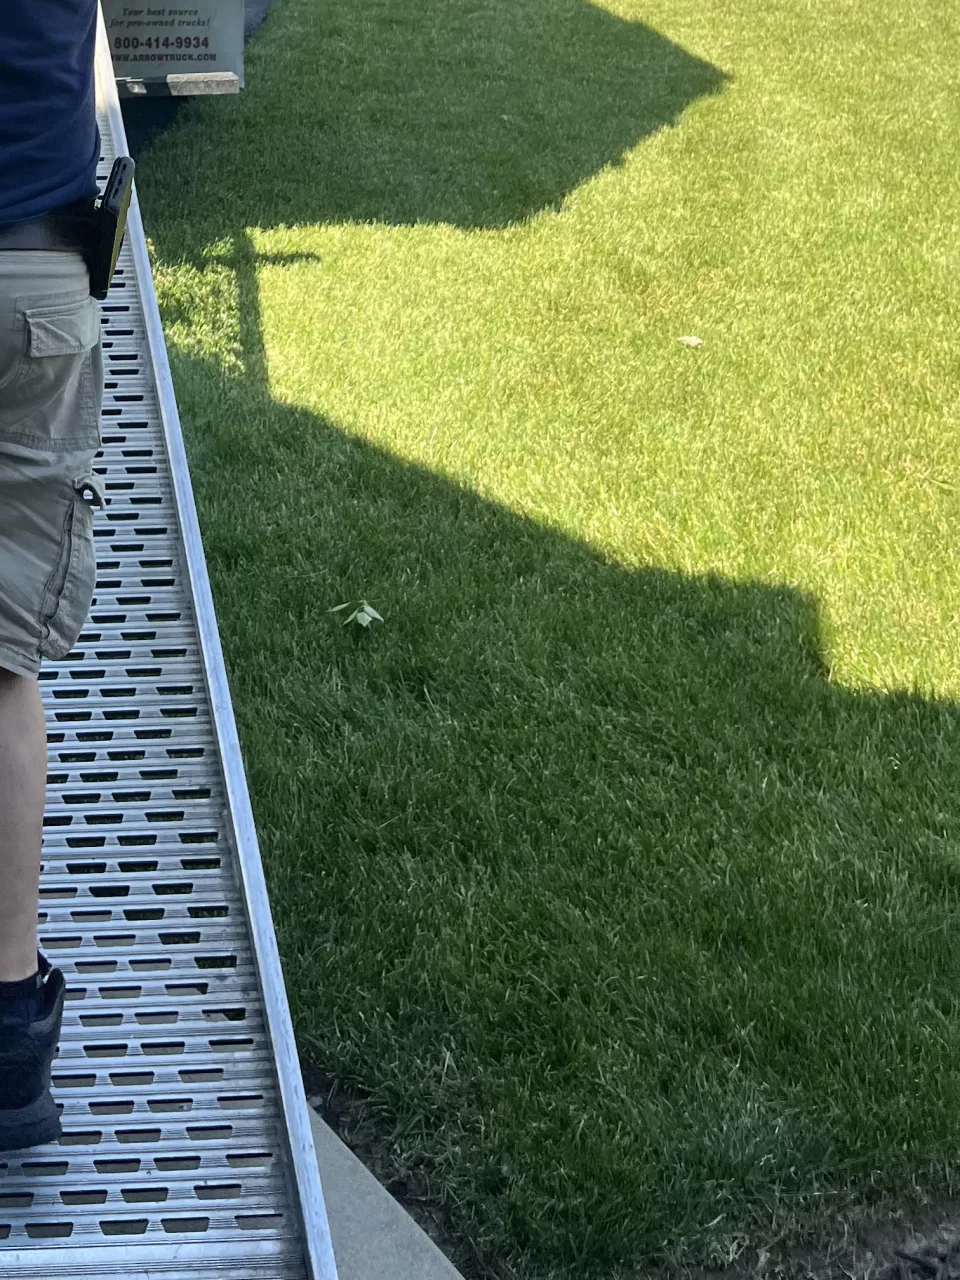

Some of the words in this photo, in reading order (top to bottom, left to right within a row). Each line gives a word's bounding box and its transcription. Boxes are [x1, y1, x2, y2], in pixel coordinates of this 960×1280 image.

[122, 8, 143, 16] Your
[146, 7, 166, 16] best
[109, 19, 127, 28] for
[127, 19, 175, 28] pre-owned
[114, 36, 209, 49] 800-414-9934
